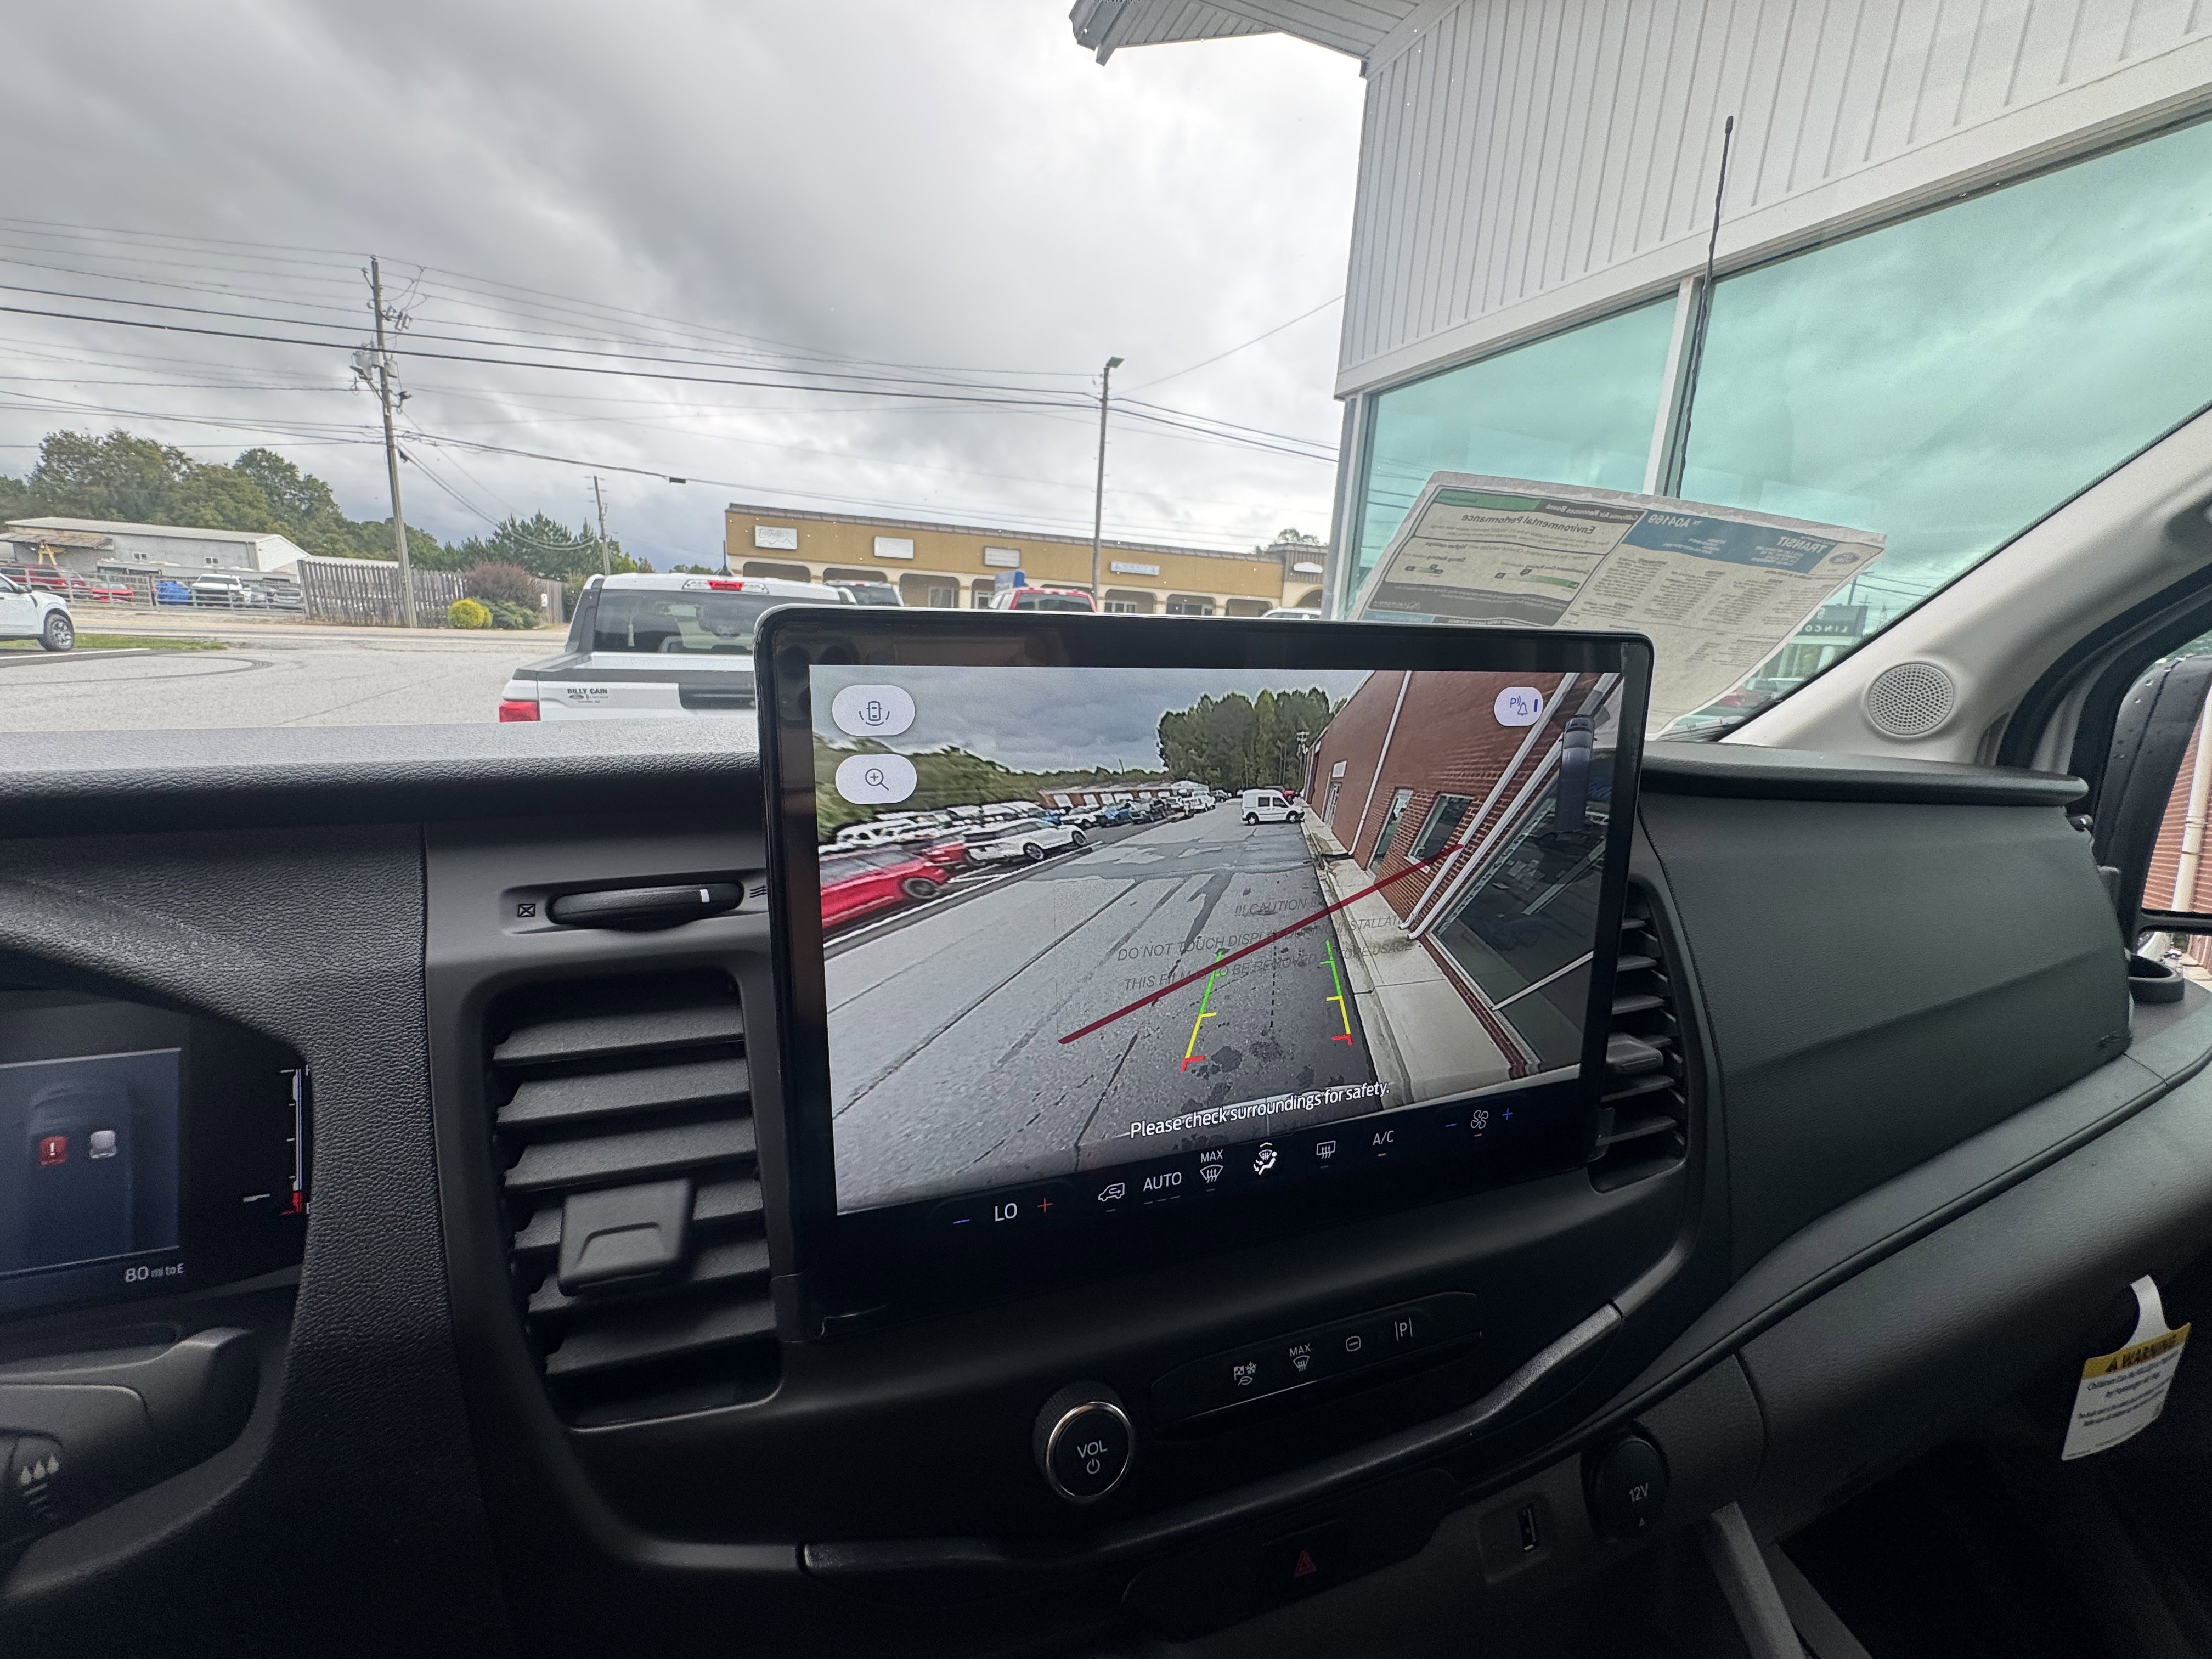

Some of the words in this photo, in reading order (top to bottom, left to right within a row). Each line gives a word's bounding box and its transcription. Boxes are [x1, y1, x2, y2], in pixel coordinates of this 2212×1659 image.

[1250, 898, 1307, 915] CAUTION
[1118, 947, 1139, 961] DO
[1143, 943, 1173, 958] NOT
[1178, 936, 1226, 955] TOUCH
[1124, 976, 1155, 991] THIS
[1233, 962, 1251, 975] BE
[1253, 954, 1317, 972] REMOVED
[1373, 940, 1414, 955] USAGE
[1130, 1117, 1182, 1138] Please
[1184, 1107, 1228, 1129] check
[1229, 1092, 1322, 1121] surroundings
[1323, 1088, 1346, 1104] for
[1346, 1082, 1391, 1102] safety.
[1373, 1130, 1395, 1147] A/C
[1200, 1149, 1224, 1163] MAX
[1143, 1171, 1183, 1192] AUTO
[994, 1203, 1019, 1223] LO
[126, 1266, 149, 1282] 80
[177, 1263, 184, 1274] E
[1290, 1342, 1312, 1357] MAX
[1077, 1440, 1108, 1458] VOL
[1629, 1482, 1650, 1502] 12V
